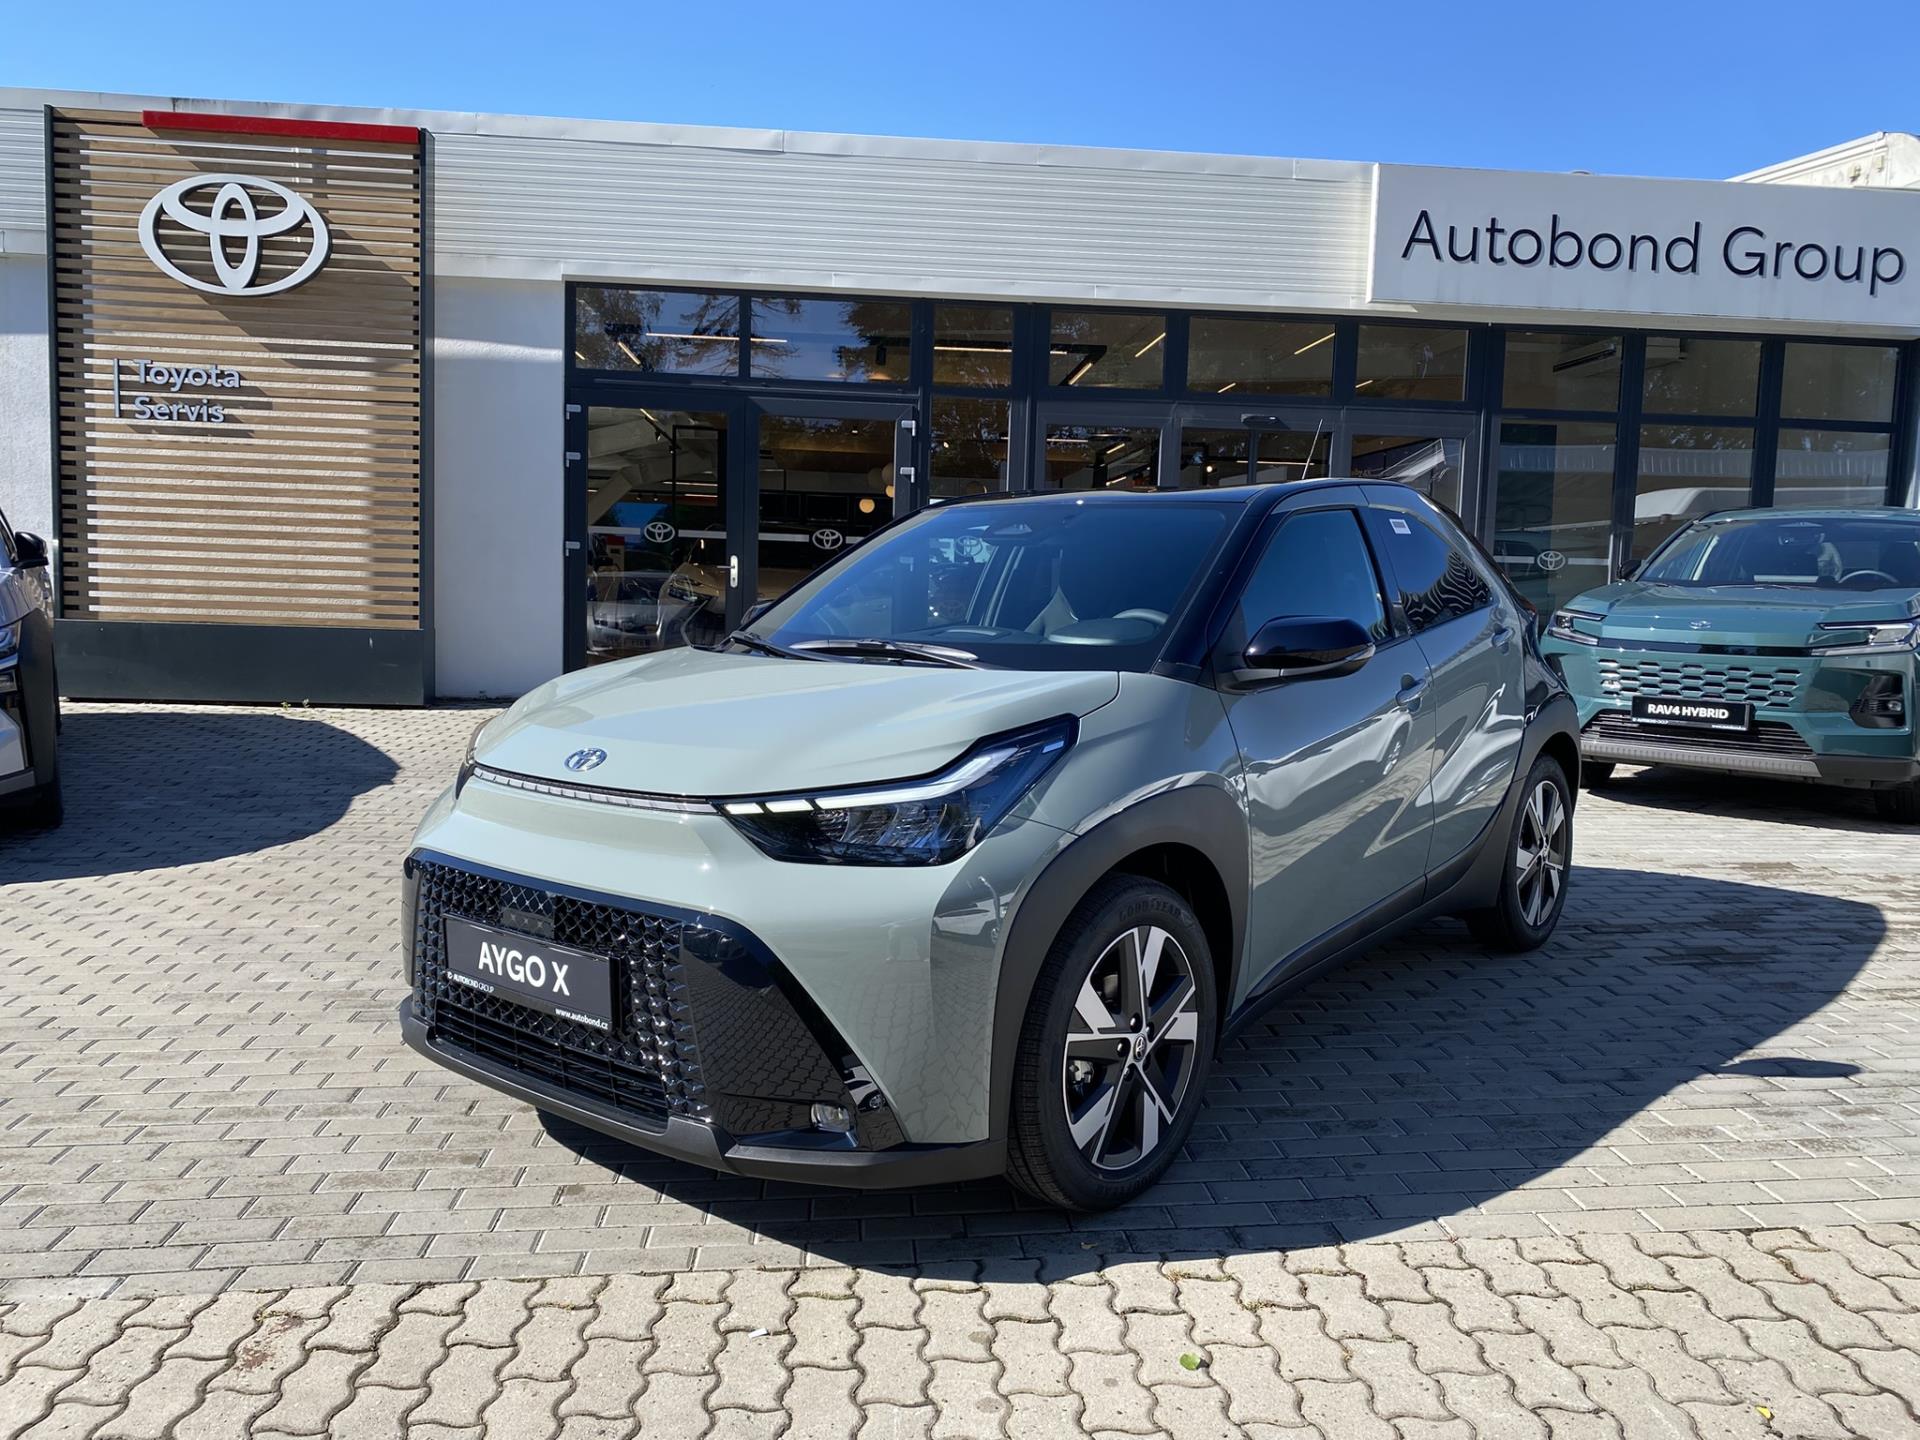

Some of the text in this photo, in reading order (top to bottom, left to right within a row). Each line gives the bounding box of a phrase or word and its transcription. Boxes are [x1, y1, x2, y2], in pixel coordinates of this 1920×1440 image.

[1401, 210, 1905, 297] Autobond Group
[133, 359, 241, 392] Toyota
[134, 395, 225, 423] Servis
[1647, 703, 1729, 719] RAV4 HYBRID
[478, 941, 570, 997] AYGO X
[555, 1008, 609, 1030] www.autobond.cz
